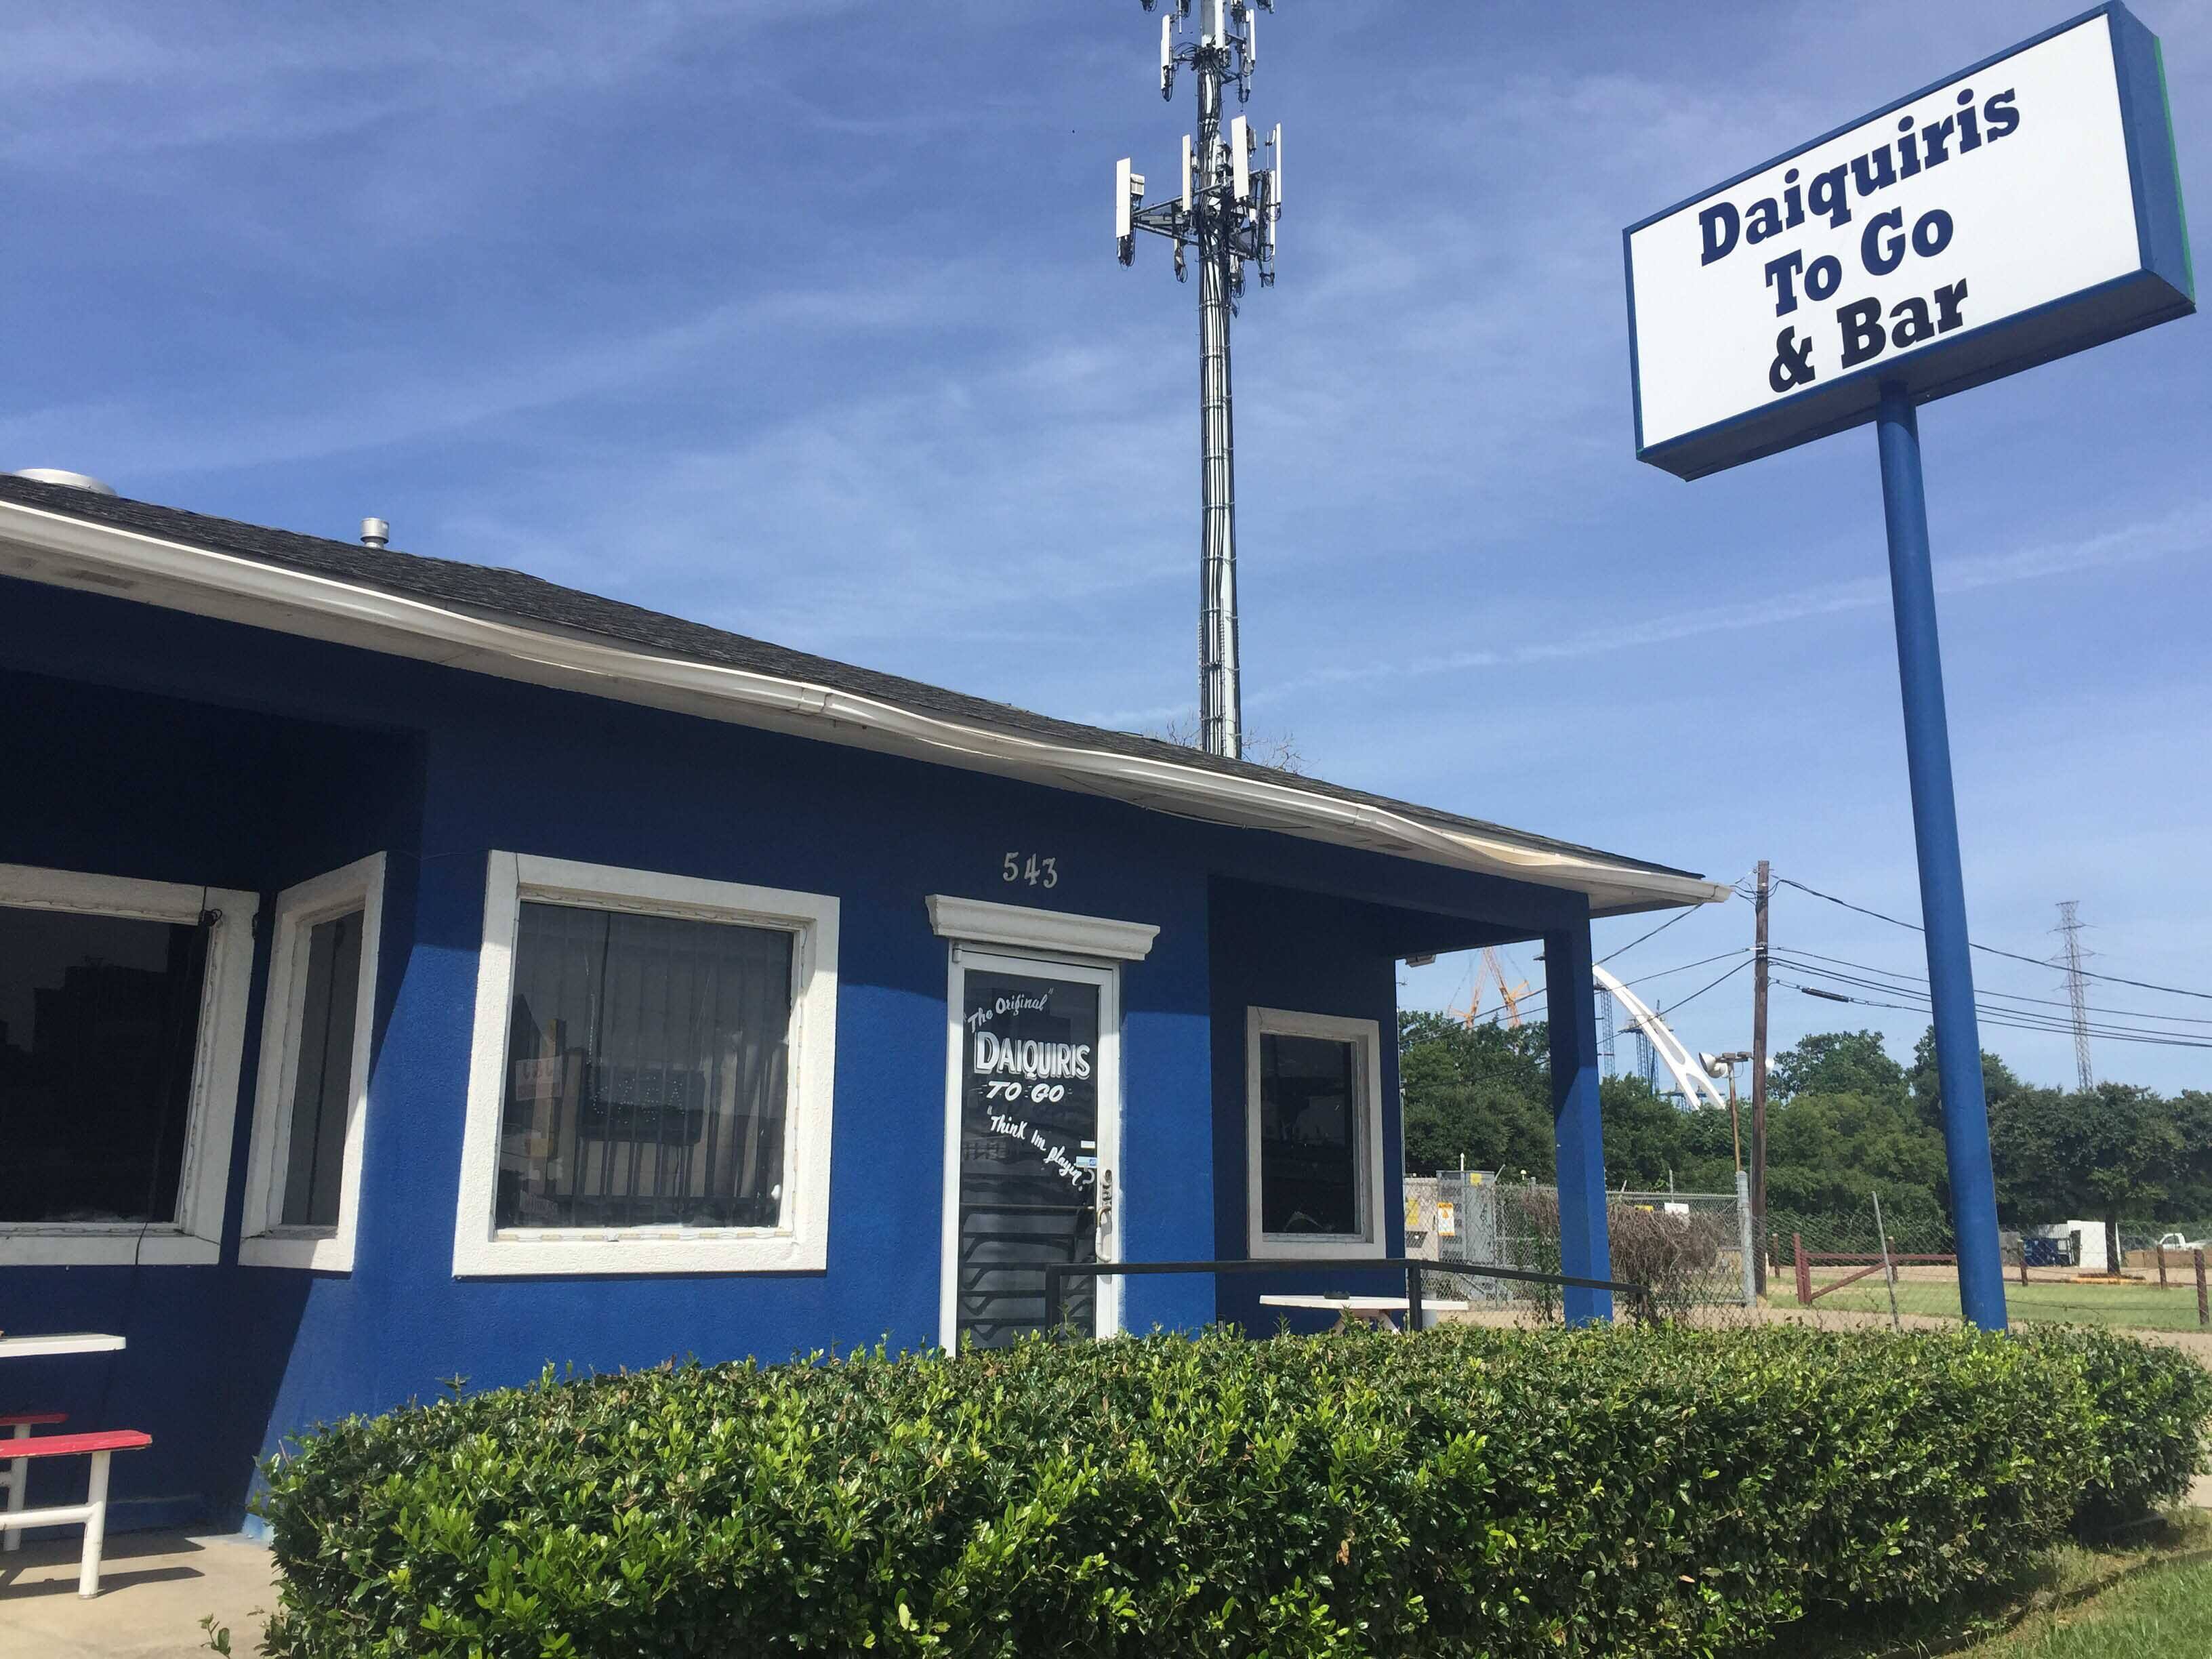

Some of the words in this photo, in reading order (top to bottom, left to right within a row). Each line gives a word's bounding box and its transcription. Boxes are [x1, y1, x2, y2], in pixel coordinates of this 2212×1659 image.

[1698, 88, 2020, 266] Daiquiris
[1765, 249, 1842, 318] To
[1860, 206, 1954, 276] Go
[1768, 326, 1816, 393] &
[1836, 278, 1968, 369] Bar
[1003, 851, 1058, 888] 543
[974, 1031, 1090, 1080] DAIQUIRIS
[986, 1080, 1022, 1101] TO
[1031, 1083, 1065, 1103] GO
